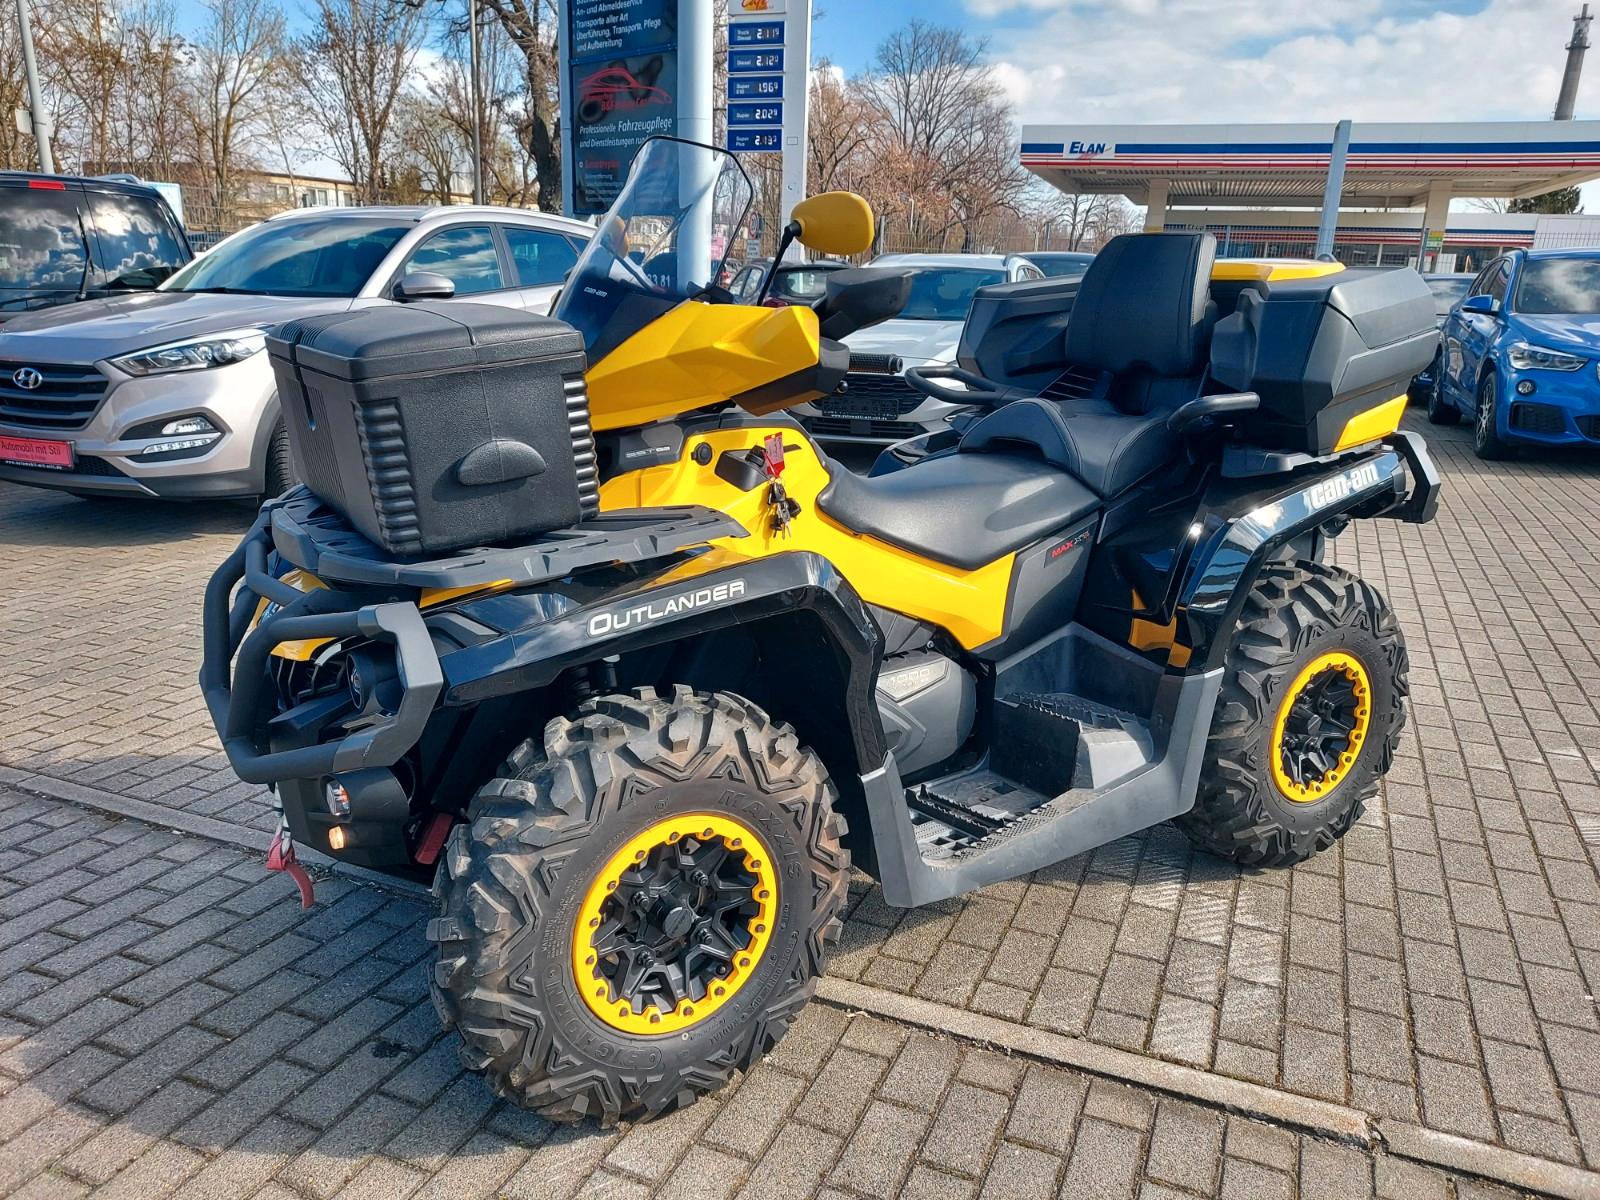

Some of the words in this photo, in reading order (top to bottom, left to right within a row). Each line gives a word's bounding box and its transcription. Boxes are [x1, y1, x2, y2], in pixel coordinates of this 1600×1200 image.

[586, 5, 598, 15] und
[598, 0, 643, 13] Abmeldeservice
[576, 17, 605, 29] Transporte
[605, 14, 619, 24] aller
[619, 12, 629, 21] Art
[643, 18, 662, 30] Pflege
[576, 44, 587, 52] und
[587, 38, 623, 50] Aufbereitung
[580, 123, 617, 134] Professionelle
[618, 115, 673, 133] Fahrzeugpflege
[580, 140, 591, 148] und
[590, 136, 636, 148] Dienstleistungen
[1069, 141, 1106, 154] ELAN
[583, 286, 608, 298] can-am
[1, 441, 34, 453] Automobil
[35, 445, 47, 455] mit
[49, 445, 61, 455] Stil
[1308, 462, 1379, 510] can-am
[588, 580, 746, 637] OUTLANDER
[716, 788, 802, 881] MAXXIS
